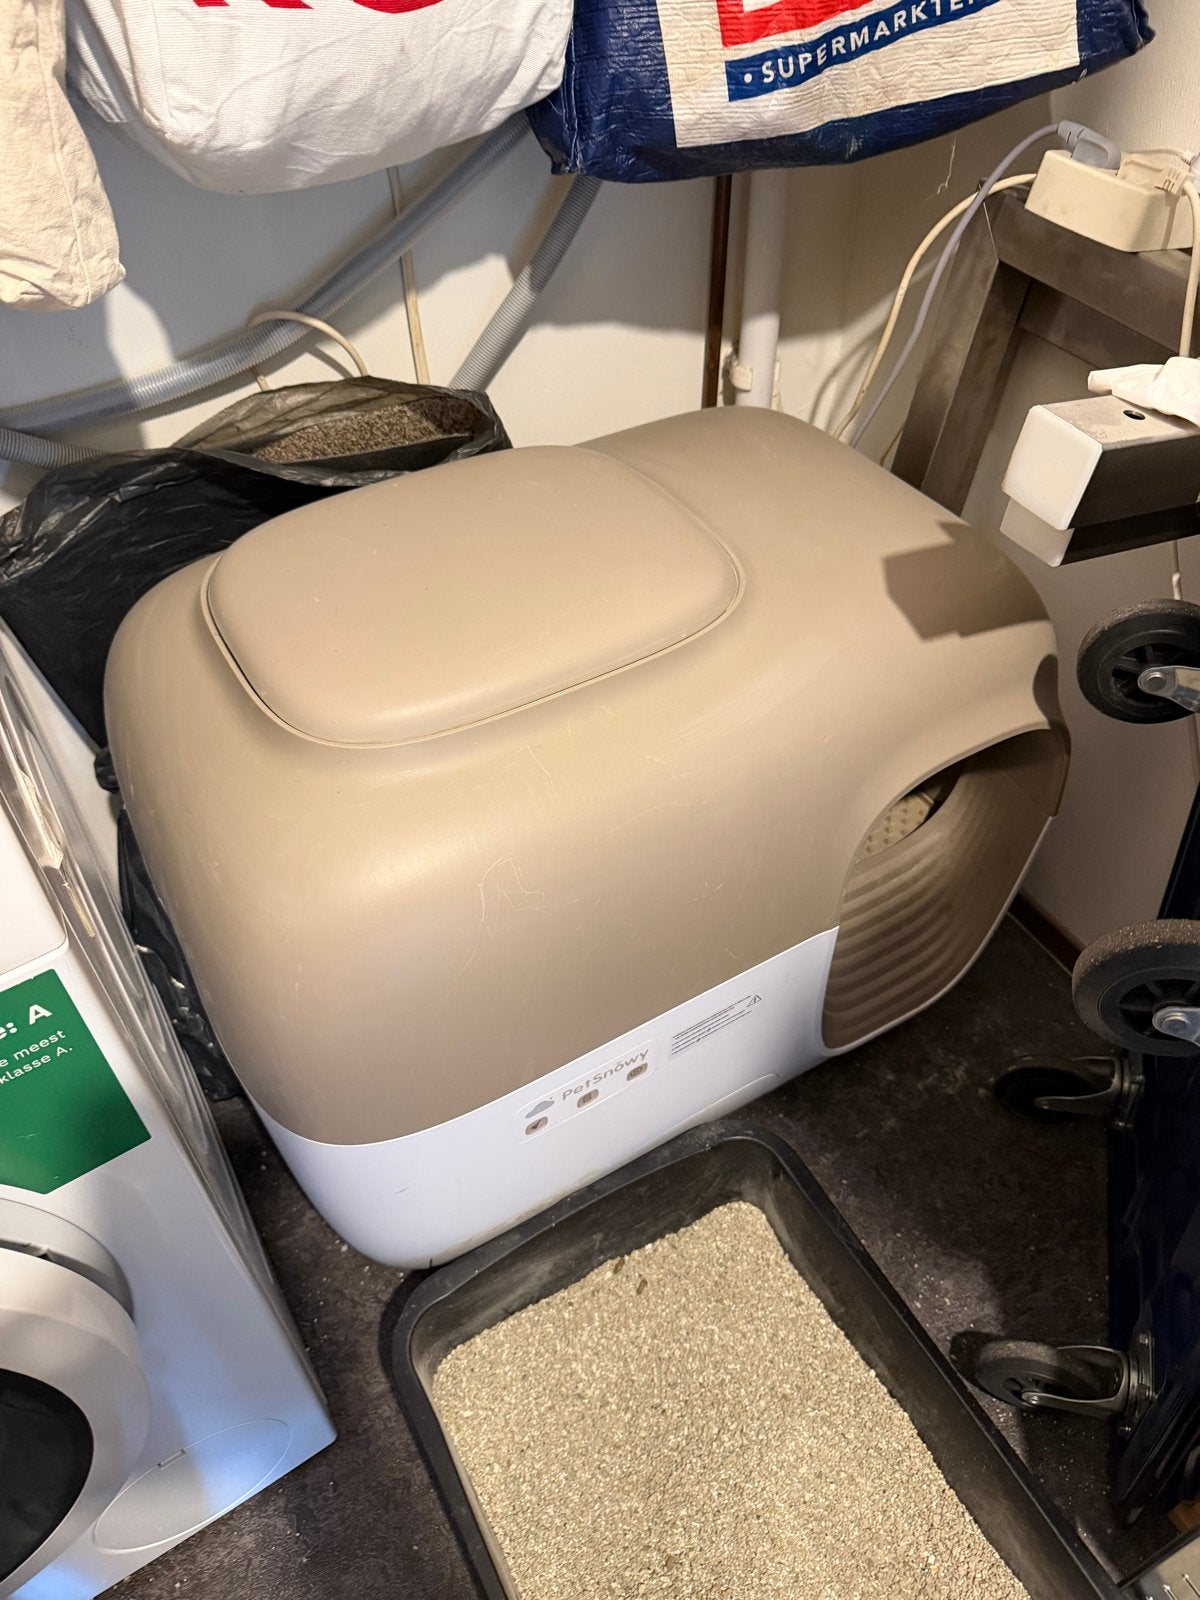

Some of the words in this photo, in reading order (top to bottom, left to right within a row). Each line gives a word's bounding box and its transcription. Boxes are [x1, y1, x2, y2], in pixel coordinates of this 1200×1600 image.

[761, 0, 974, 85] SUPERMARKTE
[29, 1004, 53, 1025] A
[13, 1030, 67, 1061] meest
[56, 1046, 73, 1057] A.
